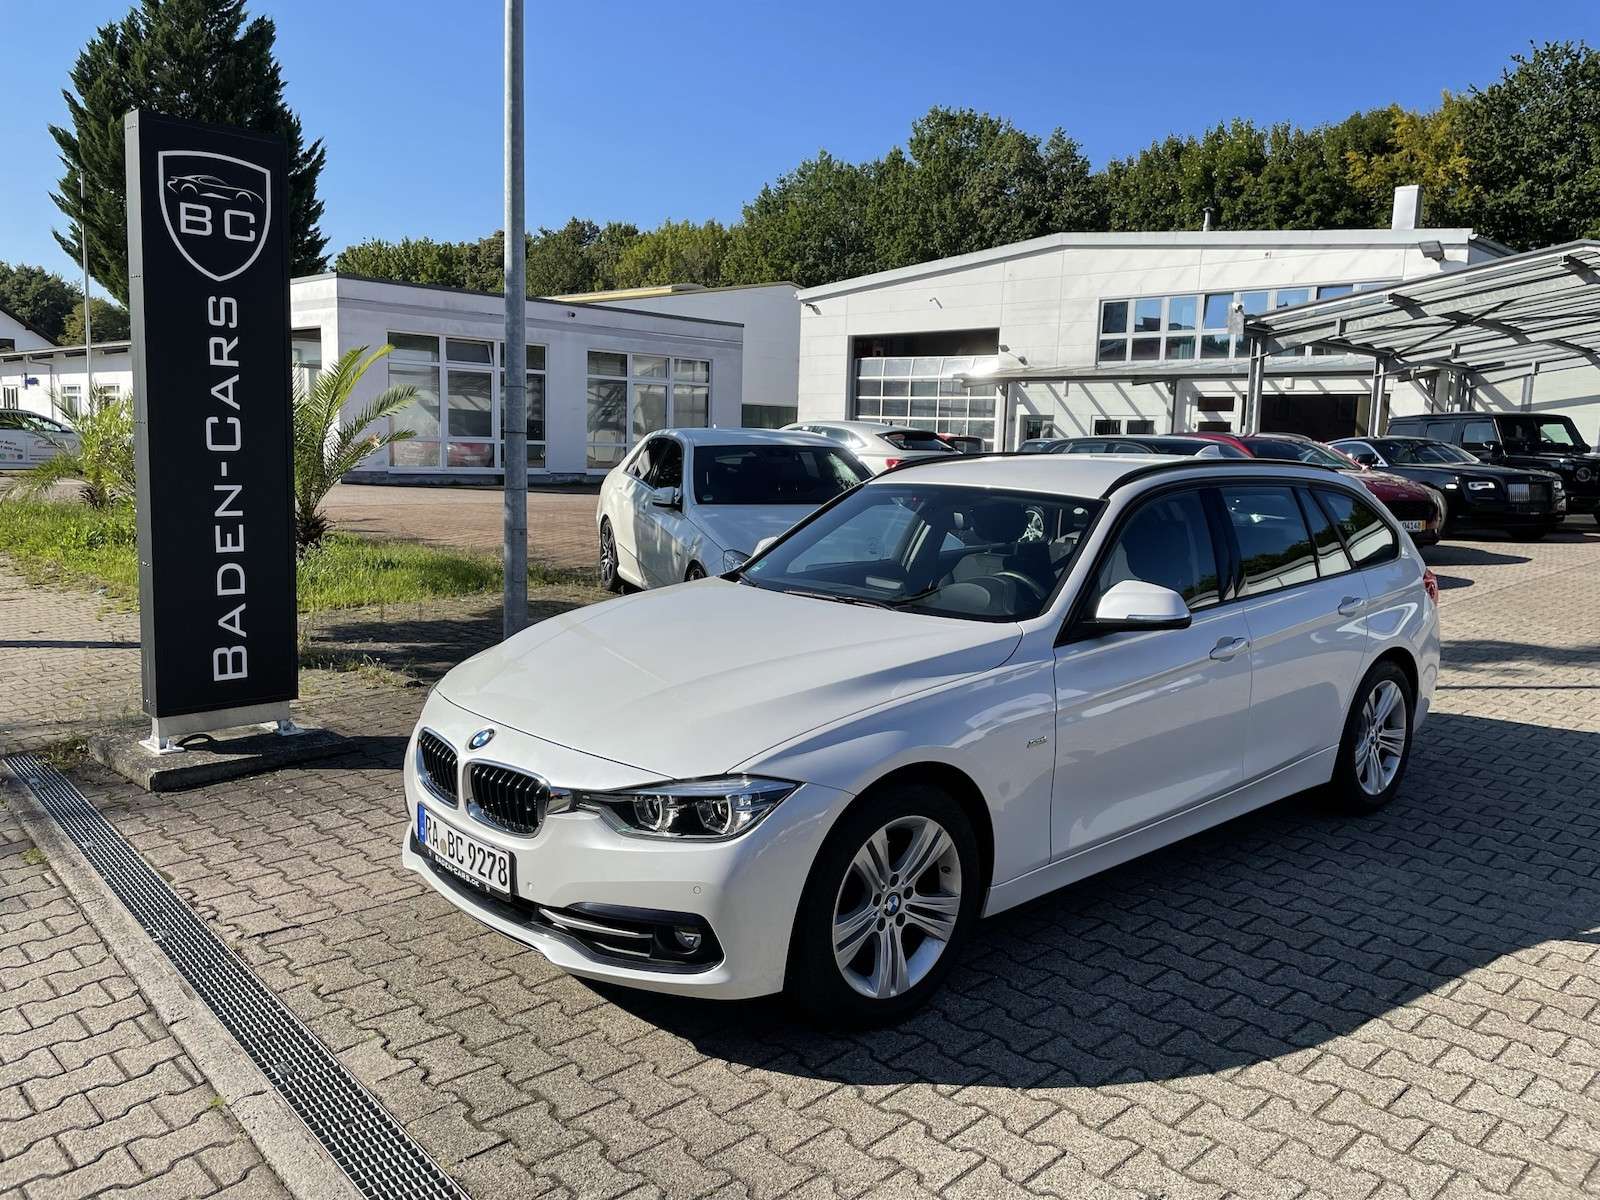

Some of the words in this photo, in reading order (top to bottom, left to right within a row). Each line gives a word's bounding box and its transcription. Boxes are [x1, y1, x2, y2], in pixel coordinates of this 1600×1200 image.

[205, 295, 249, 682] BADEN-CARS
[425, 814, 439, 850] RA
[447, 829, 464, 865] BC
[468, 841, 508, 887] 9278
